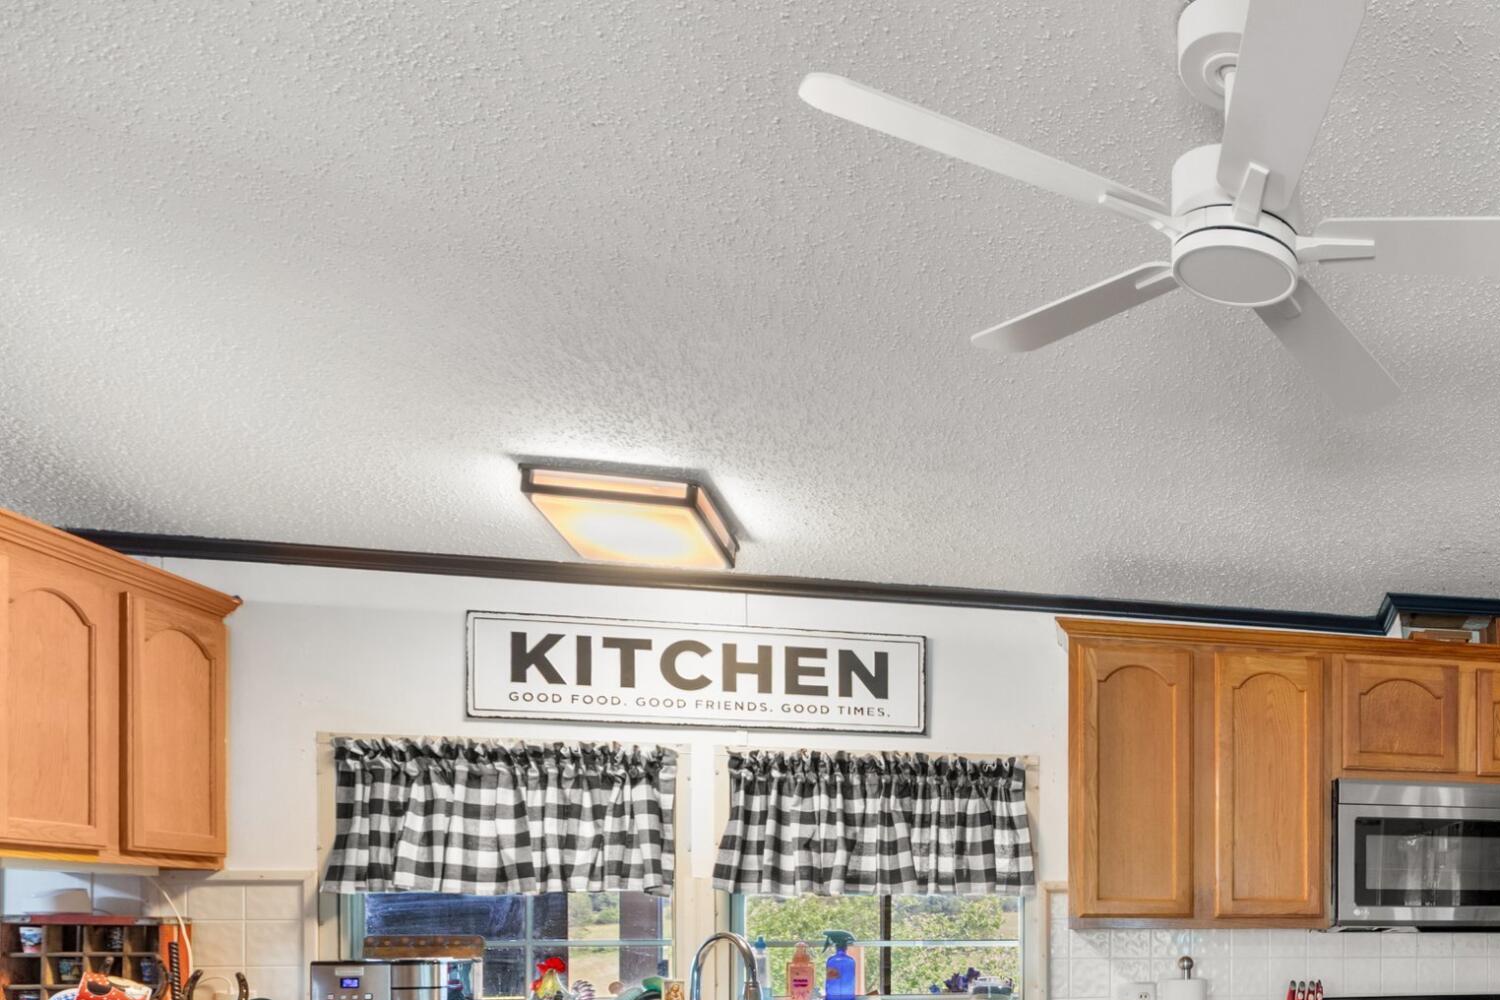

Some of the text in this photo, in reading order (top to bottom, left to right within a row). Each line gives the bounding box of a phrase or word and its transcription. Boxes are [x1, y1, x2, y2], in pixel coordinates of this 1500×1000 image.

[510, 631, 889, 700] KITCHEN
[508, 691, 891, 718] GOOD FOOD. GOOD FRIENDS. GOOD TIMES.
